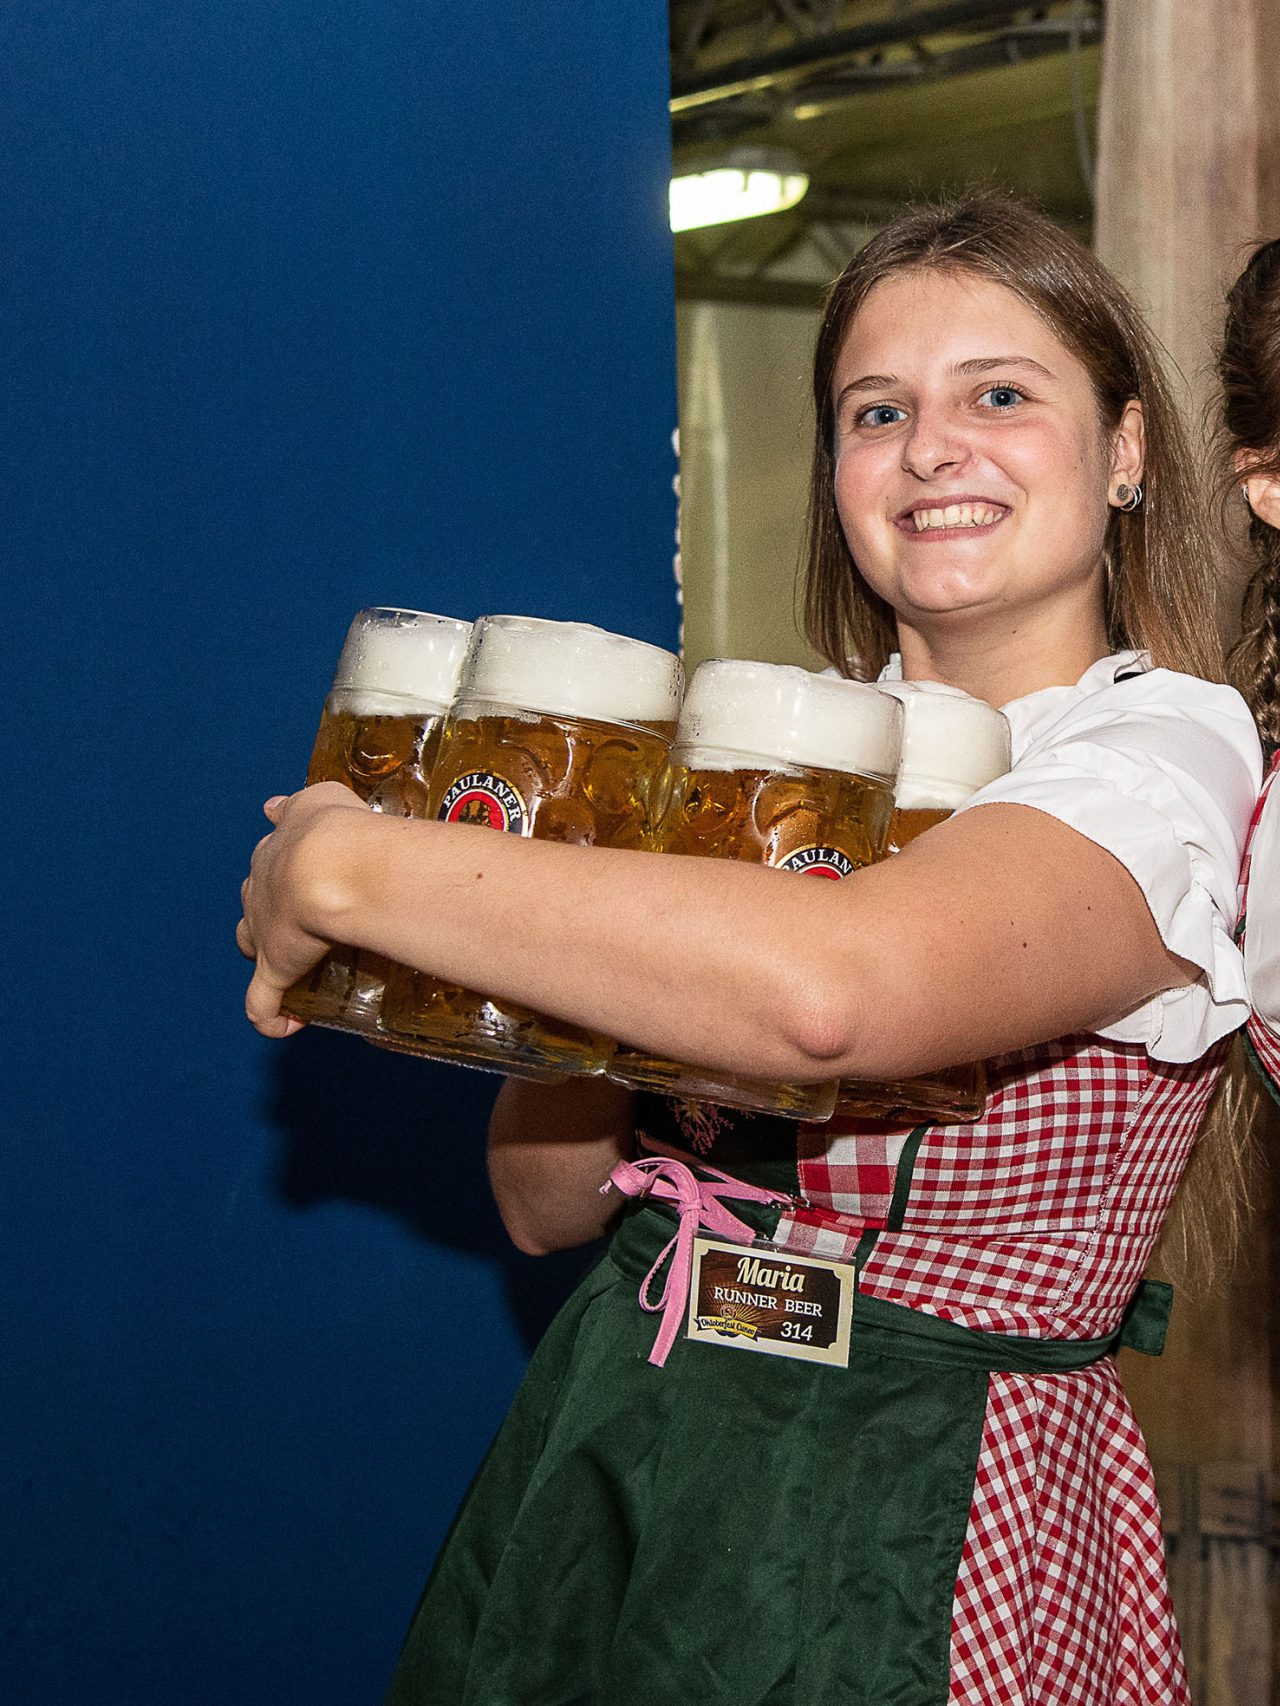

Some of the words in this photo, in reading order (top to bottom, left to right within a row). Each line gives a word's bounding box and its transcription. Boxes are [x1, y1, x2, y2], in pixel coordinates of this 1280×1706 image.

[443, 774, 521, 822] PAULANER
[782, 848, 854, 874] AULAN
[737, 1257, 805, 1293] Maria
[714, 1286, 778, 1310] RUNNER
[784, 1298, 823, 1317] BEER
[780, 1321, 813, 1341] 314
